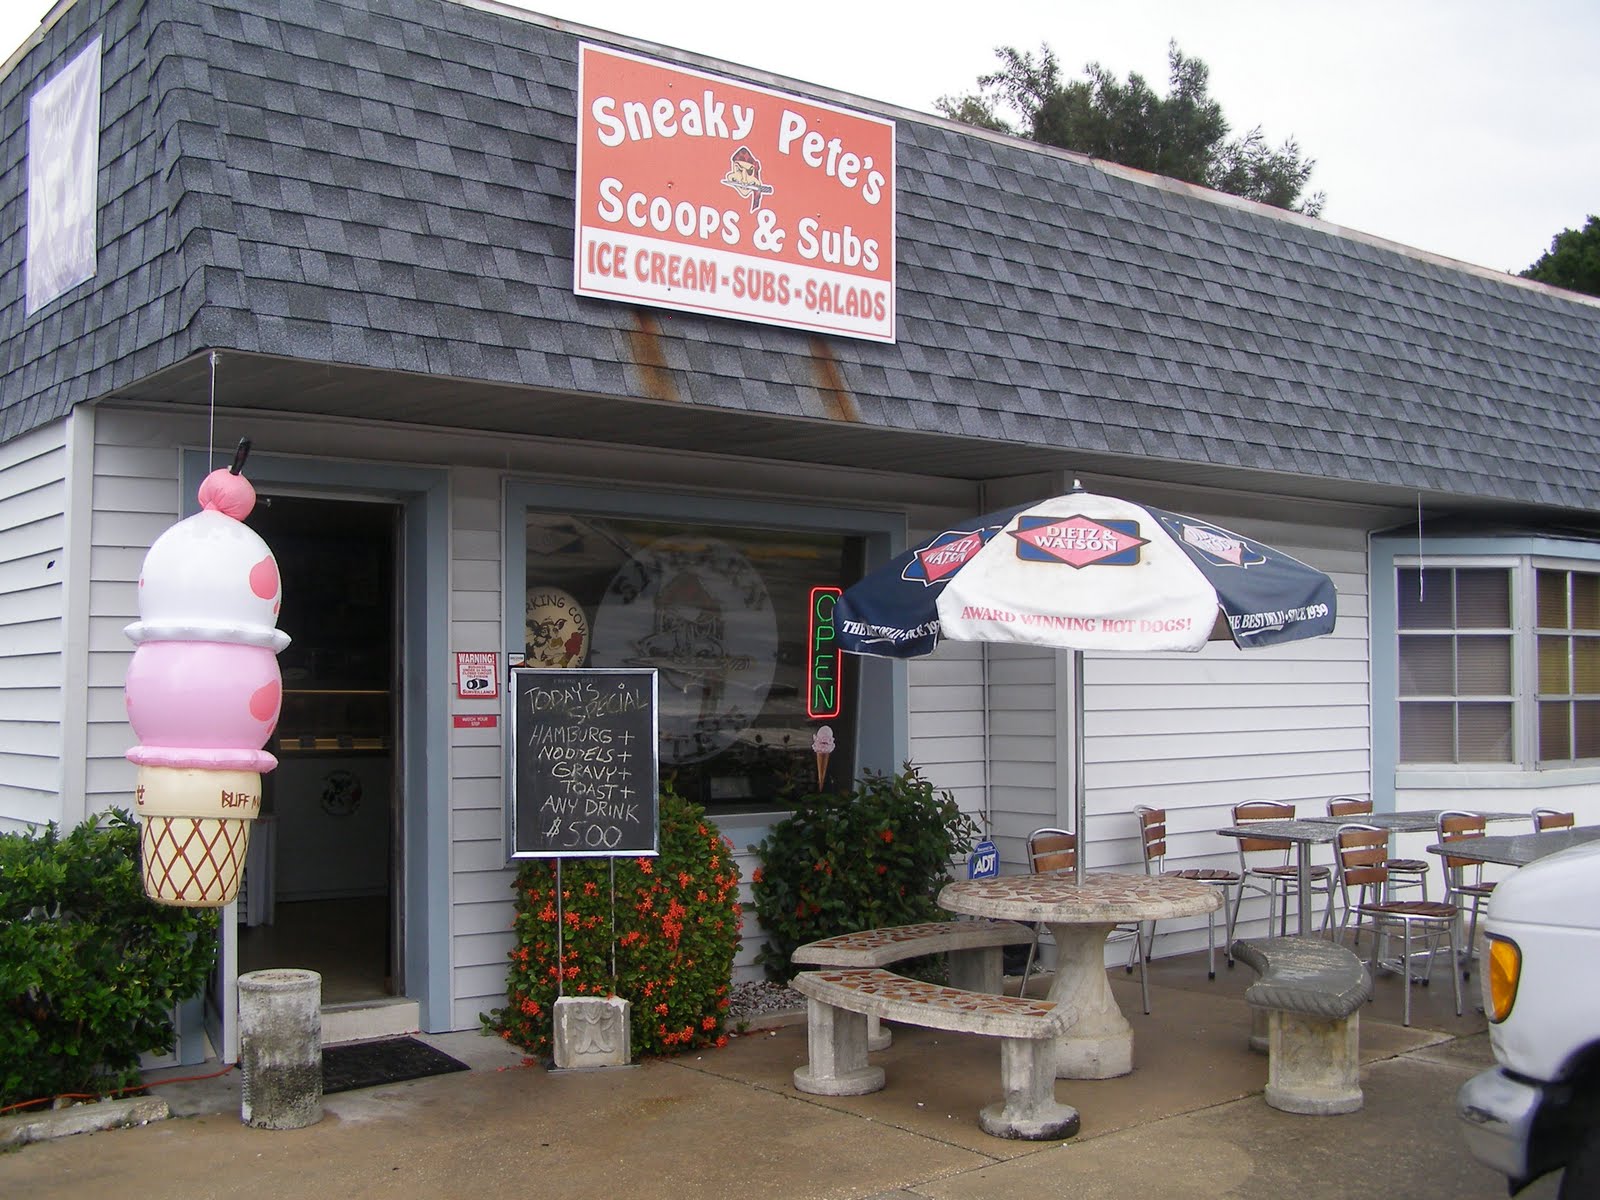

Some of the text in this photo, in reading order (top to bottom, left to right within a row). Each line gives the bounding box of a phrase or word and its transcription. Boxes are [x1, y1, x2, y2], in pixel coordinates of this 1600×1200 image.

[592, 90, 885, 205] Sneaky Pete's
[597, 176, 880, 272] Scoops & Subs
[588, 240, 627, 279] ICE
[634, 249, 717, 293] CREAM
[732, 266, 790, 305] SUBS
[804, 278, 886, 321] SALADS
[1034, 535, 1119, 552] WATSON
[1046, 526, 1118, 541] DIETZ &
[568, 606, 587, 637] COW
[960, 606, 1192, 633] AWARD WINNING HOT DOGS!
[1241, 613, 1265, 629] BEST
[1305, 603, 1329, 620] 1939
[842, 620, 866, 636] THE
[458, 653, 495, 664] WARNING!
[814, 594, 837, 709] OPEN
[528, 725, 613, 747] HAMBURG
[551, 761, 617, 782] GRAVY
[221, 789, 250, 809] BUFF
[560, 780, 619, 800] TOAST
[540, 795, 640, 824] ANY DRINK
[974, 853, 996, 875] ADT
